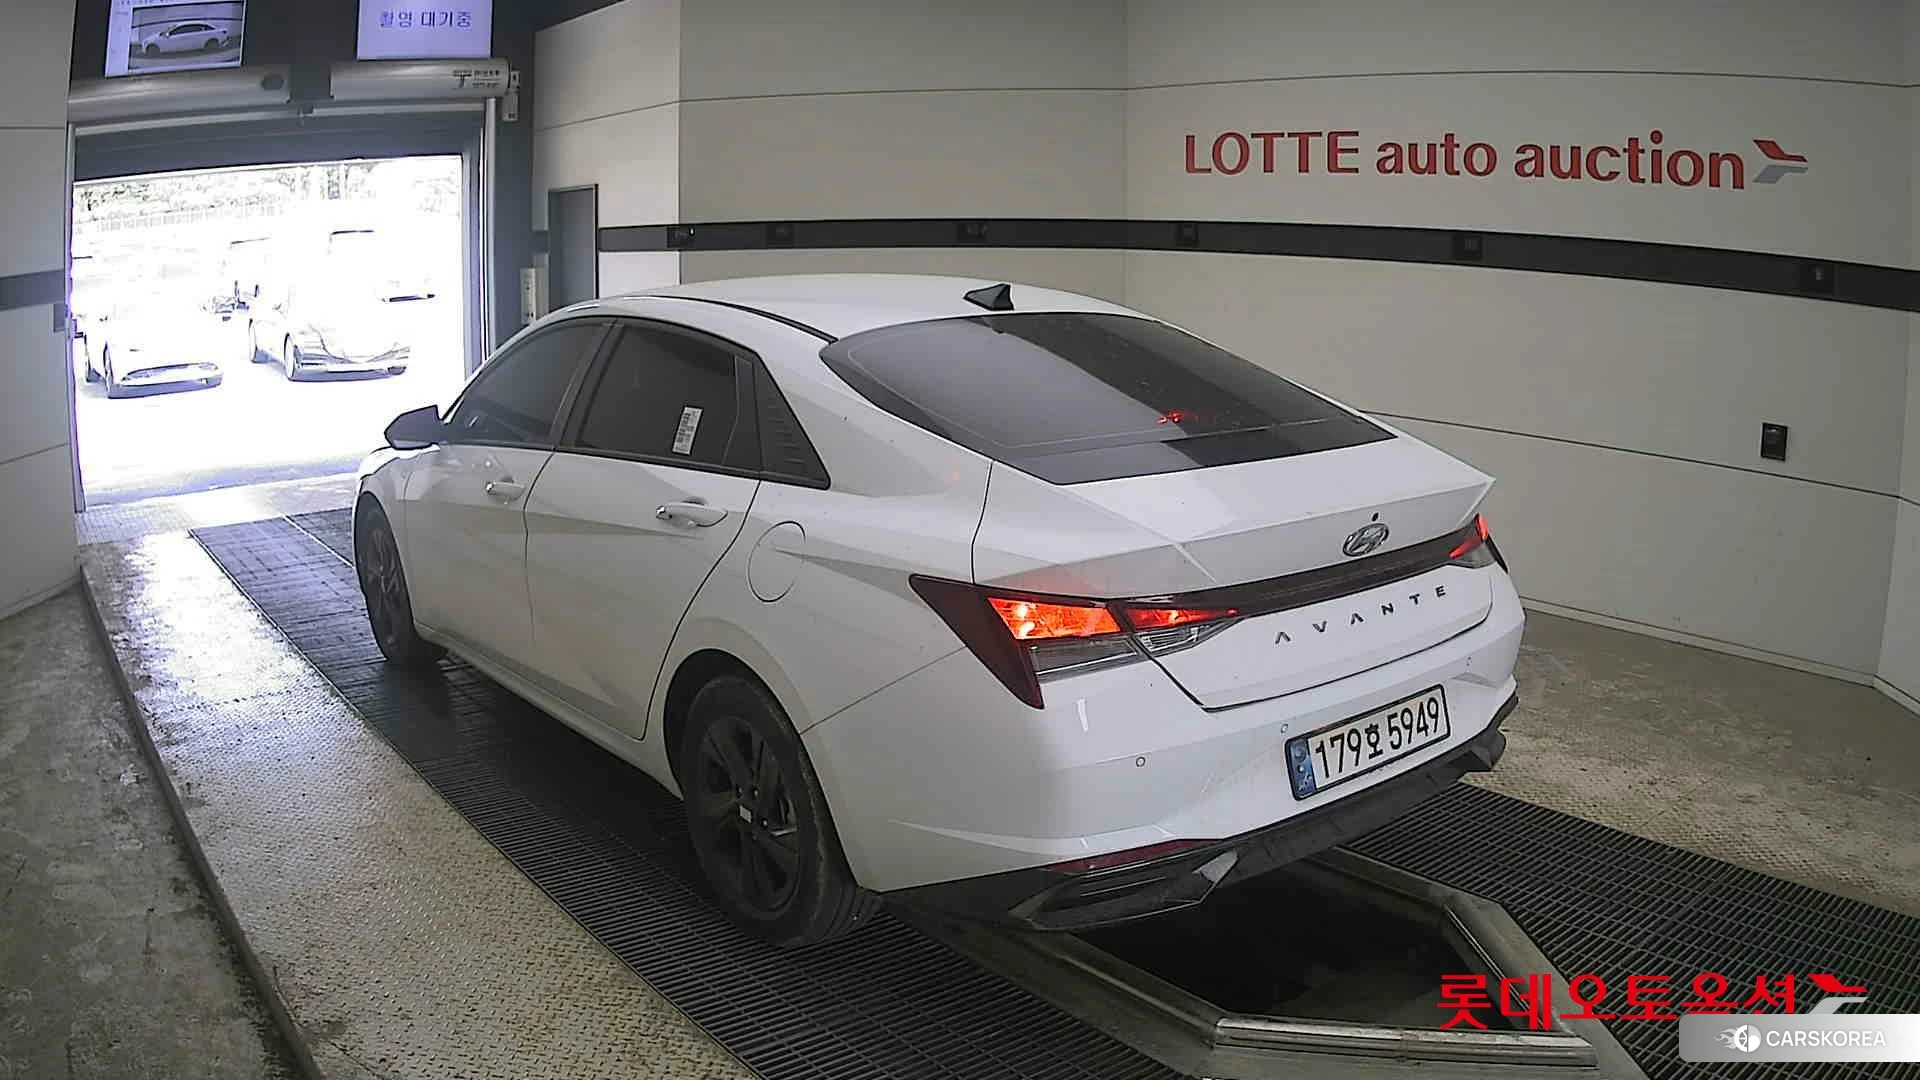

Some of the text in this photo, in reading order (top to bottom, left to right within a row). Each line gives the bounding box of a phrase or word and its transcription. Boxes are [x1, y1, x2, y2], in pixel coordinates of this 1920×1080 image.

[421, 10, 472, 28] 대기중
[1185, 130, 1745, 190] LOTTE auto auction
[1274, 585, 1447, 645] AVANTE
[1314, 696, 1440, 779] 179호 5949
